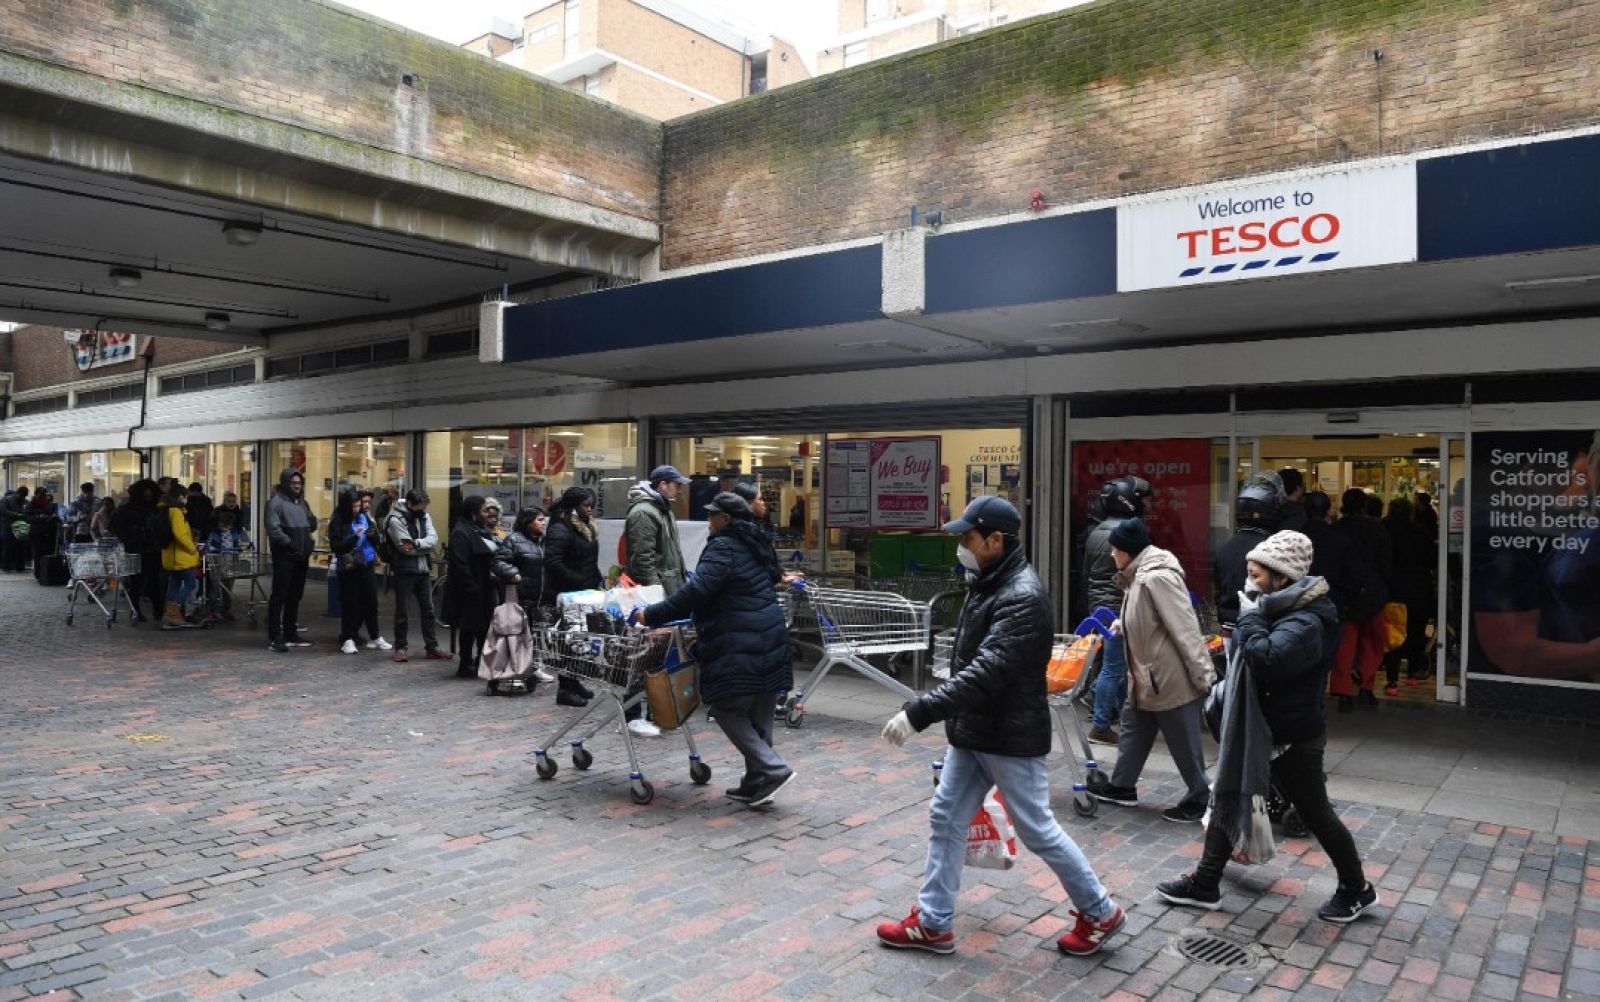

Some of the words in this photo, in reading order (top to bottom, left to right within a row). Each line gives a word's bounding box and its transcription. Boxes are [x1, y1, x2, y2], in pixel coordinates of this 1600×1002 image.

[1198, 195, 1285, 220] Welcome
[1293, 190, 1314, 207] to
[1176, 213, 1340, 258] TESCO
[878, 459, 900, 480] We
[903, 455, 933, 483] Buy
[1088, 458, 1139, 475] we're
[1143, 462, 1191, 480] open
[1490, 448, 1568, 469] Serving
[1490, 469, 1587, 486] Catford's
[1490, 490, 1589, 511] shoppers
[1490, 511, 1537, 528] little
[1489, 535, 1548, 553] every
[1551, 533, 1591, 554] day
